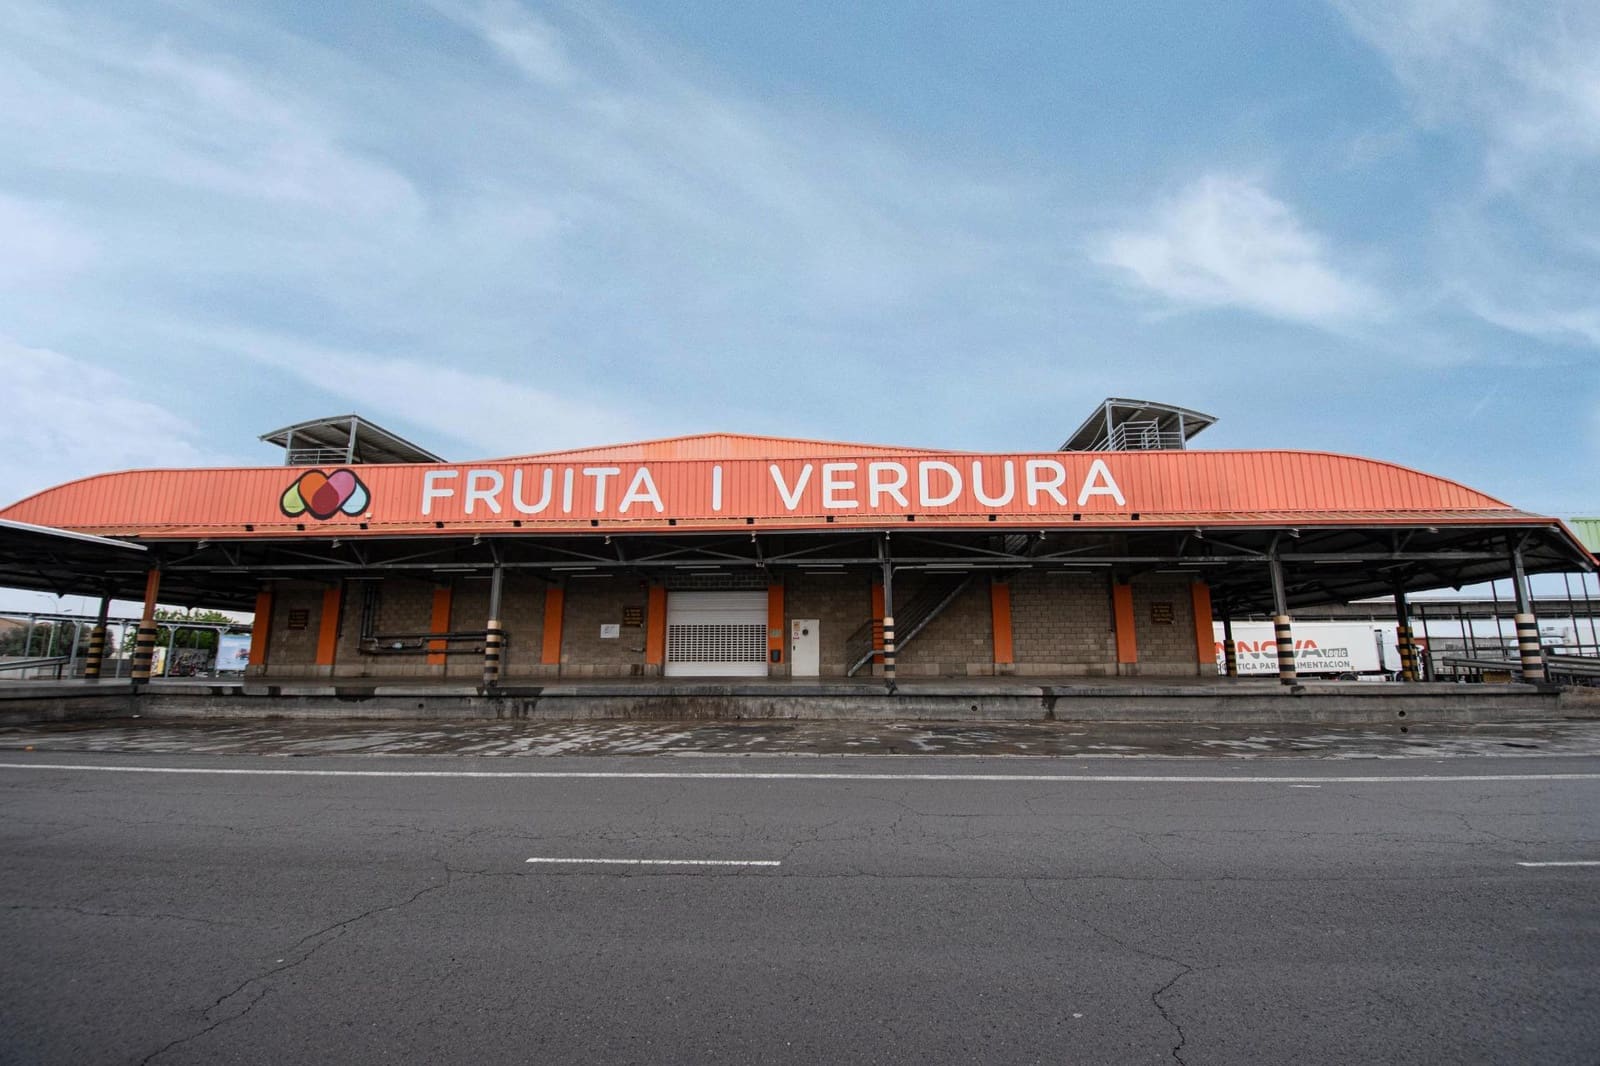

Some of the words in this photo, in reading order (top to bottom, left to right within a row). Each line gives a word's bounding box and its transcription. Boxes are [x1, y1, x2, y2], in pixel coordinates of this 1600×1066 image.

[421, 466, 665, 515] FRUITA
[712, 465, 723, 511] I
[769, 458, 1126, 511] VERDURA
[1295, 661, 1350, 669] IMENTACION
